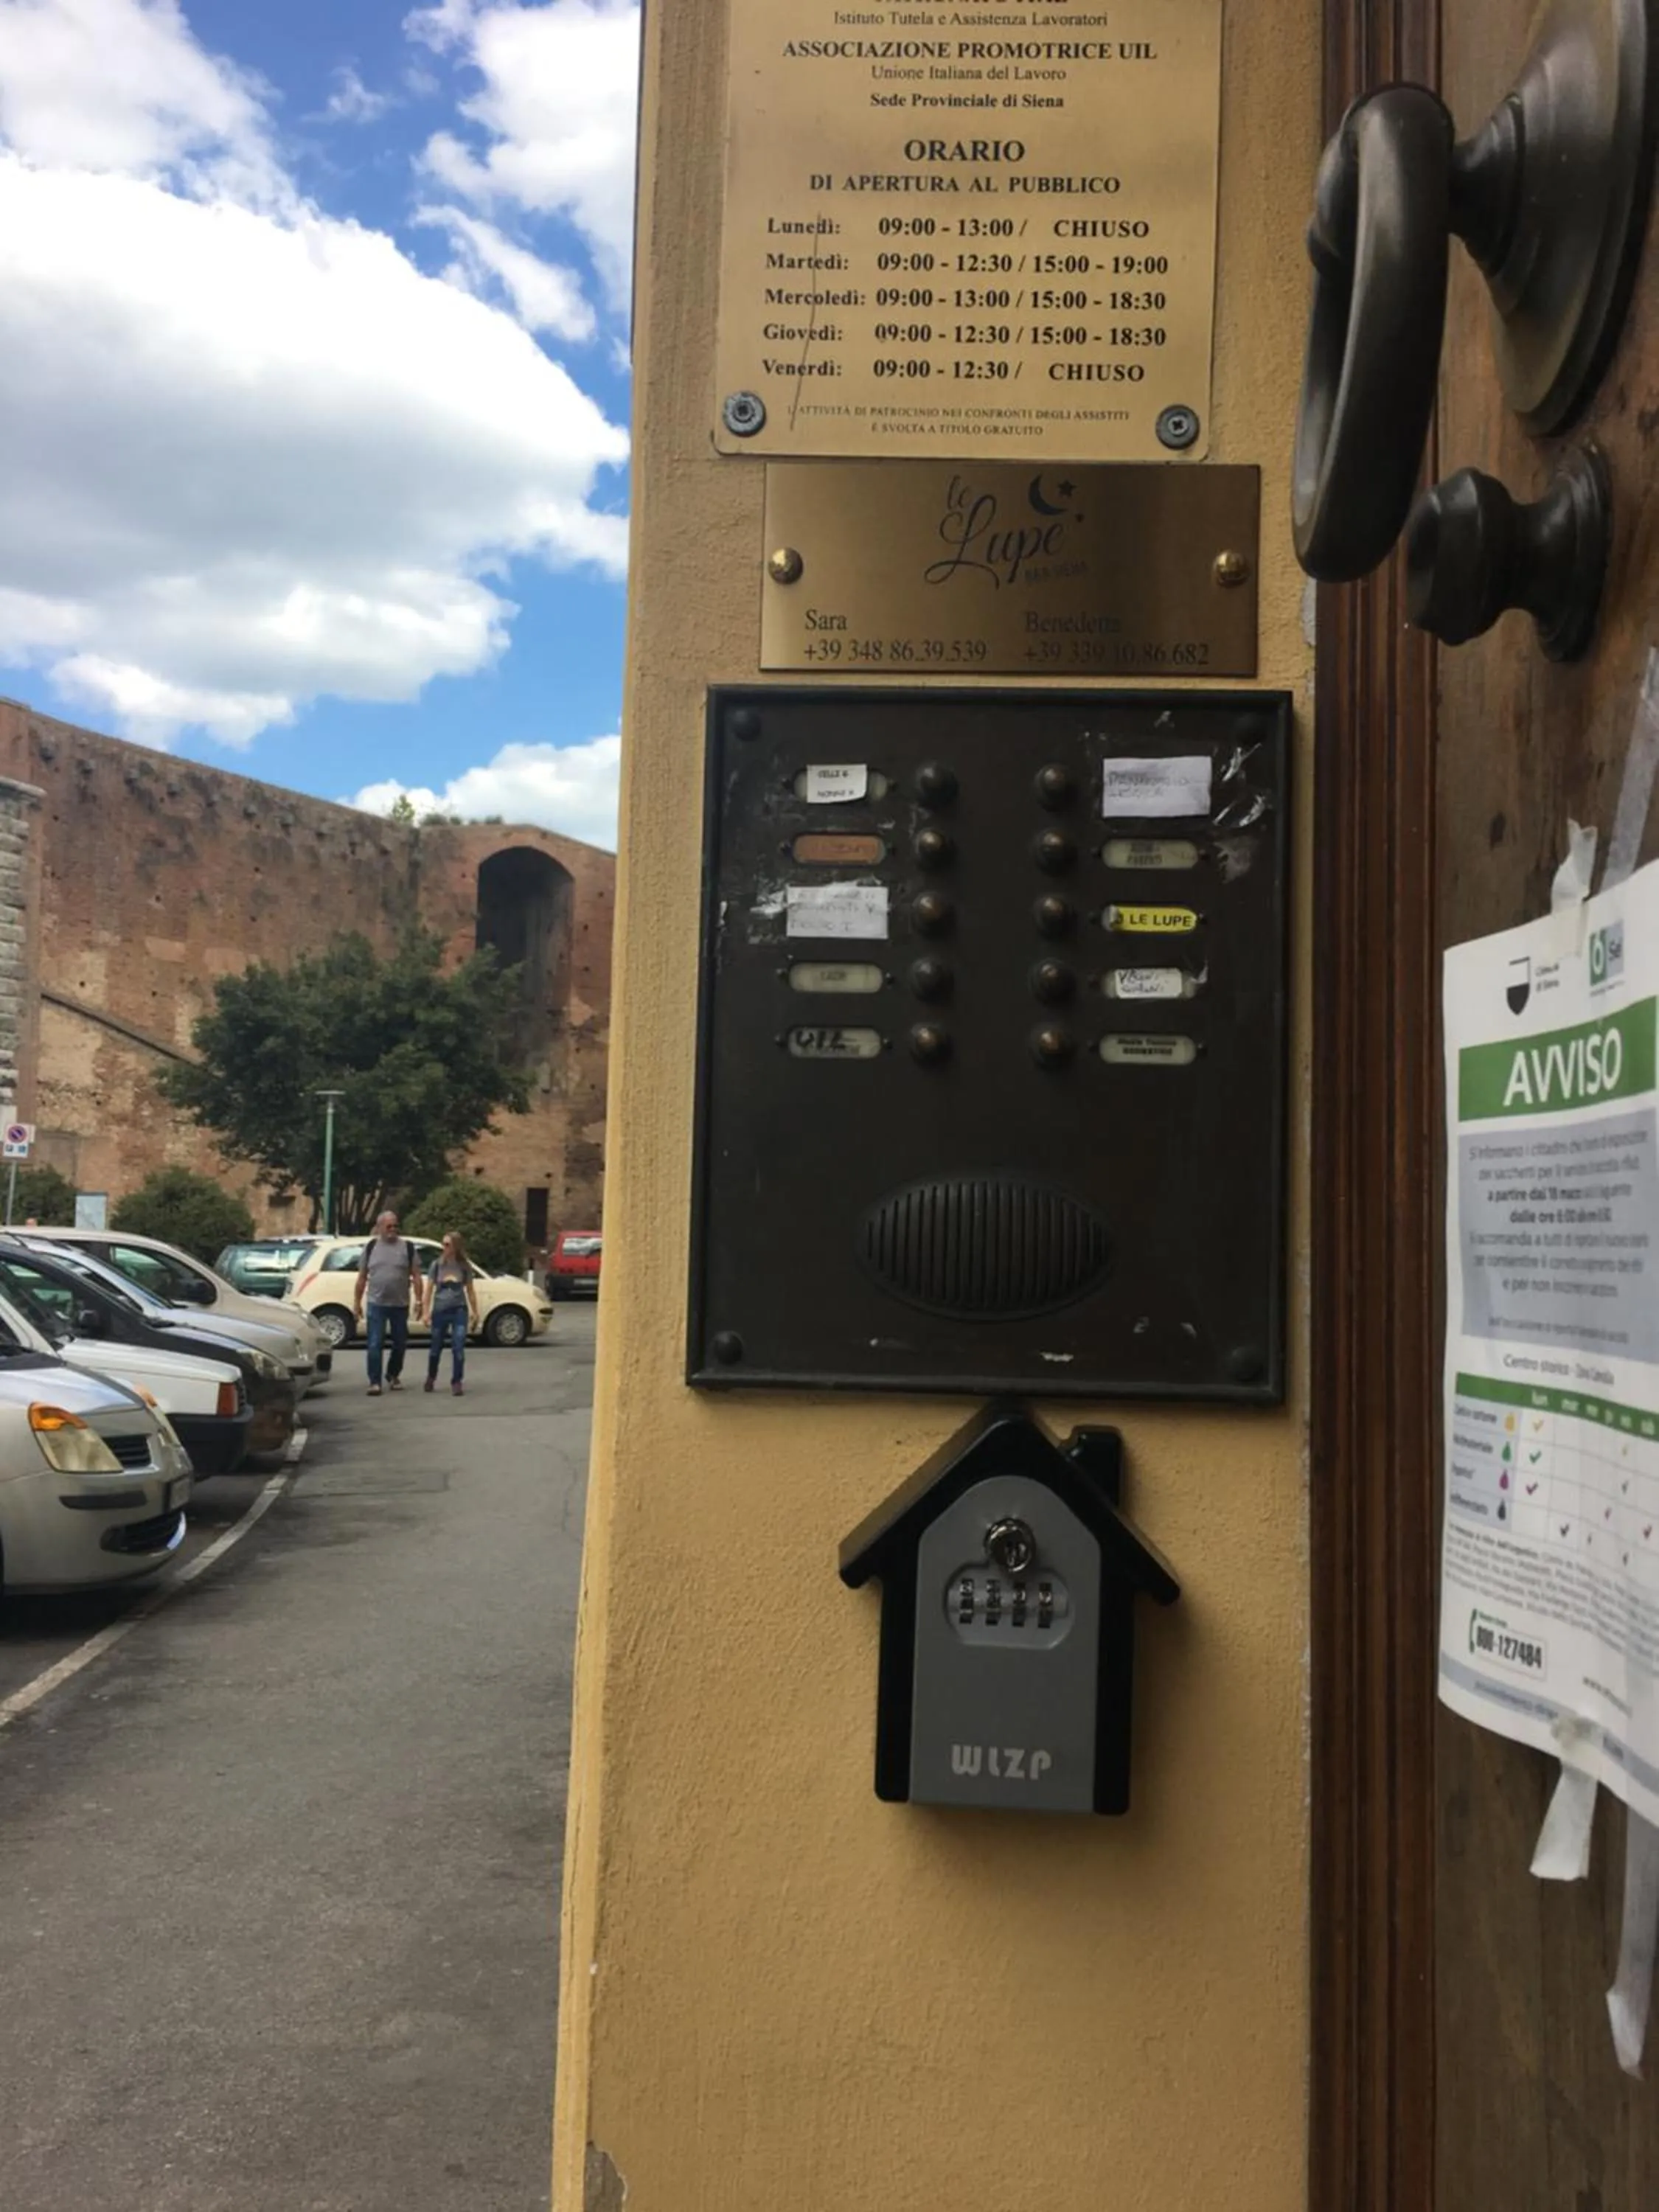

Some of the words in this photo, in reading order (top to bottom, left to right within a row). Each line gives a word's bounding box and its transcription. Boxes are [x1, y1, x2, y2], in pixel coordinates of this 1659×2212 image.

[835, 11, 884, 24] Istituto
[891, 12, 933, 24] Tutela
[938, 15, 946, 25] e
[950, 13, 1026, 25] Assistenza
[1032, 12, 1107, 26] Lavoratori
[783, 42, 950, 58] ASSOCIAZIONE
[959, 43, 1111, 58] PROMOTRICE
[1120, 44, 1156, 59] UIL
[872, 66, 923, 79] Unione
[930, 66, 982, 79] Italiana
[987, 66, 1009, 80] del
[1015, 67, 1066, 80] Lavoro
[871, 94, 906, 106] Sede
[912, 94, 997, 107] Provinciale
[1004, 94, 1017, 107] di
[1023, 94, 1063, 107] Siena
[905, 140, 1025, 161] ORARIO
[810, 175, 831, 190] DI
[843, 175, 959, 192] APERTURA
[970, 177, 997, 192] AL
[1009, 177, 1120, 192] PUBBLICO
[768, 218, 840, 234] Lunedì:
[879, 218, 935, 234] 09:00
[959, 219, 1013, 236] 13:00
[1054, 220, 1149, 237] CHIUSO
[767, 254, 848, 270] Martedì:
[878, 253, 933, 271] 09:00
[958, 254, 1012, 271] 12:30
[1035, 256, 1089, 273] 15:00
[1113, 257, 1167, 274] 19:00
[765, 289, 865, 305] Mercoledì:
[877, 289, 932, 306] 09:00
[956, 290, 1009, 307] 13:00
[1032, 291, 1087, 308] 15:00
[1111, 293, 1165, 310] 18:30
[763, 324, 842, 341] Giovedì:
[875, 324, 931, 341] 09:00
[956, 326, 1009, 343] 12:30
[1032, 327, 1086, 344] 15:00
[1111, 328, 1166, 345] 18:30
[762, 360, 841, 376] Venerdì:
[874, 360, 930, 378] 09:00
[955, 361, 1008, 379] 12:30
[1048, 364, 1144, 381] CHIUSO
[854, 406, 867, 416] DI
[870, 407, 939, 417] PATROCINIO
[943, 408, 961, 417] NEI
[964, 408, 1032, 419] CONFRONTI
[1035, 410, 1071, 420] DEGLI
[1074, 410, 1130, 420] ASSISTITI
[882, 423, 924, 434] SVOLTA
[928, 424, 936, 434] A
[940, 425, 981, 434] TITOLO
[984, 425, 1043, 435] GRATUITO
[805, 609, 847, 630] Sara
[804, 639, 842, 661] +39
[848, 639, 883, 661] 348
[1024, 640, 1061, 662] +39
[1130, 914, 1148, 925] LE
[1153, 914, 1192, 927] LUPE
[1503, 1027, 1621, 1106] AVVISO
